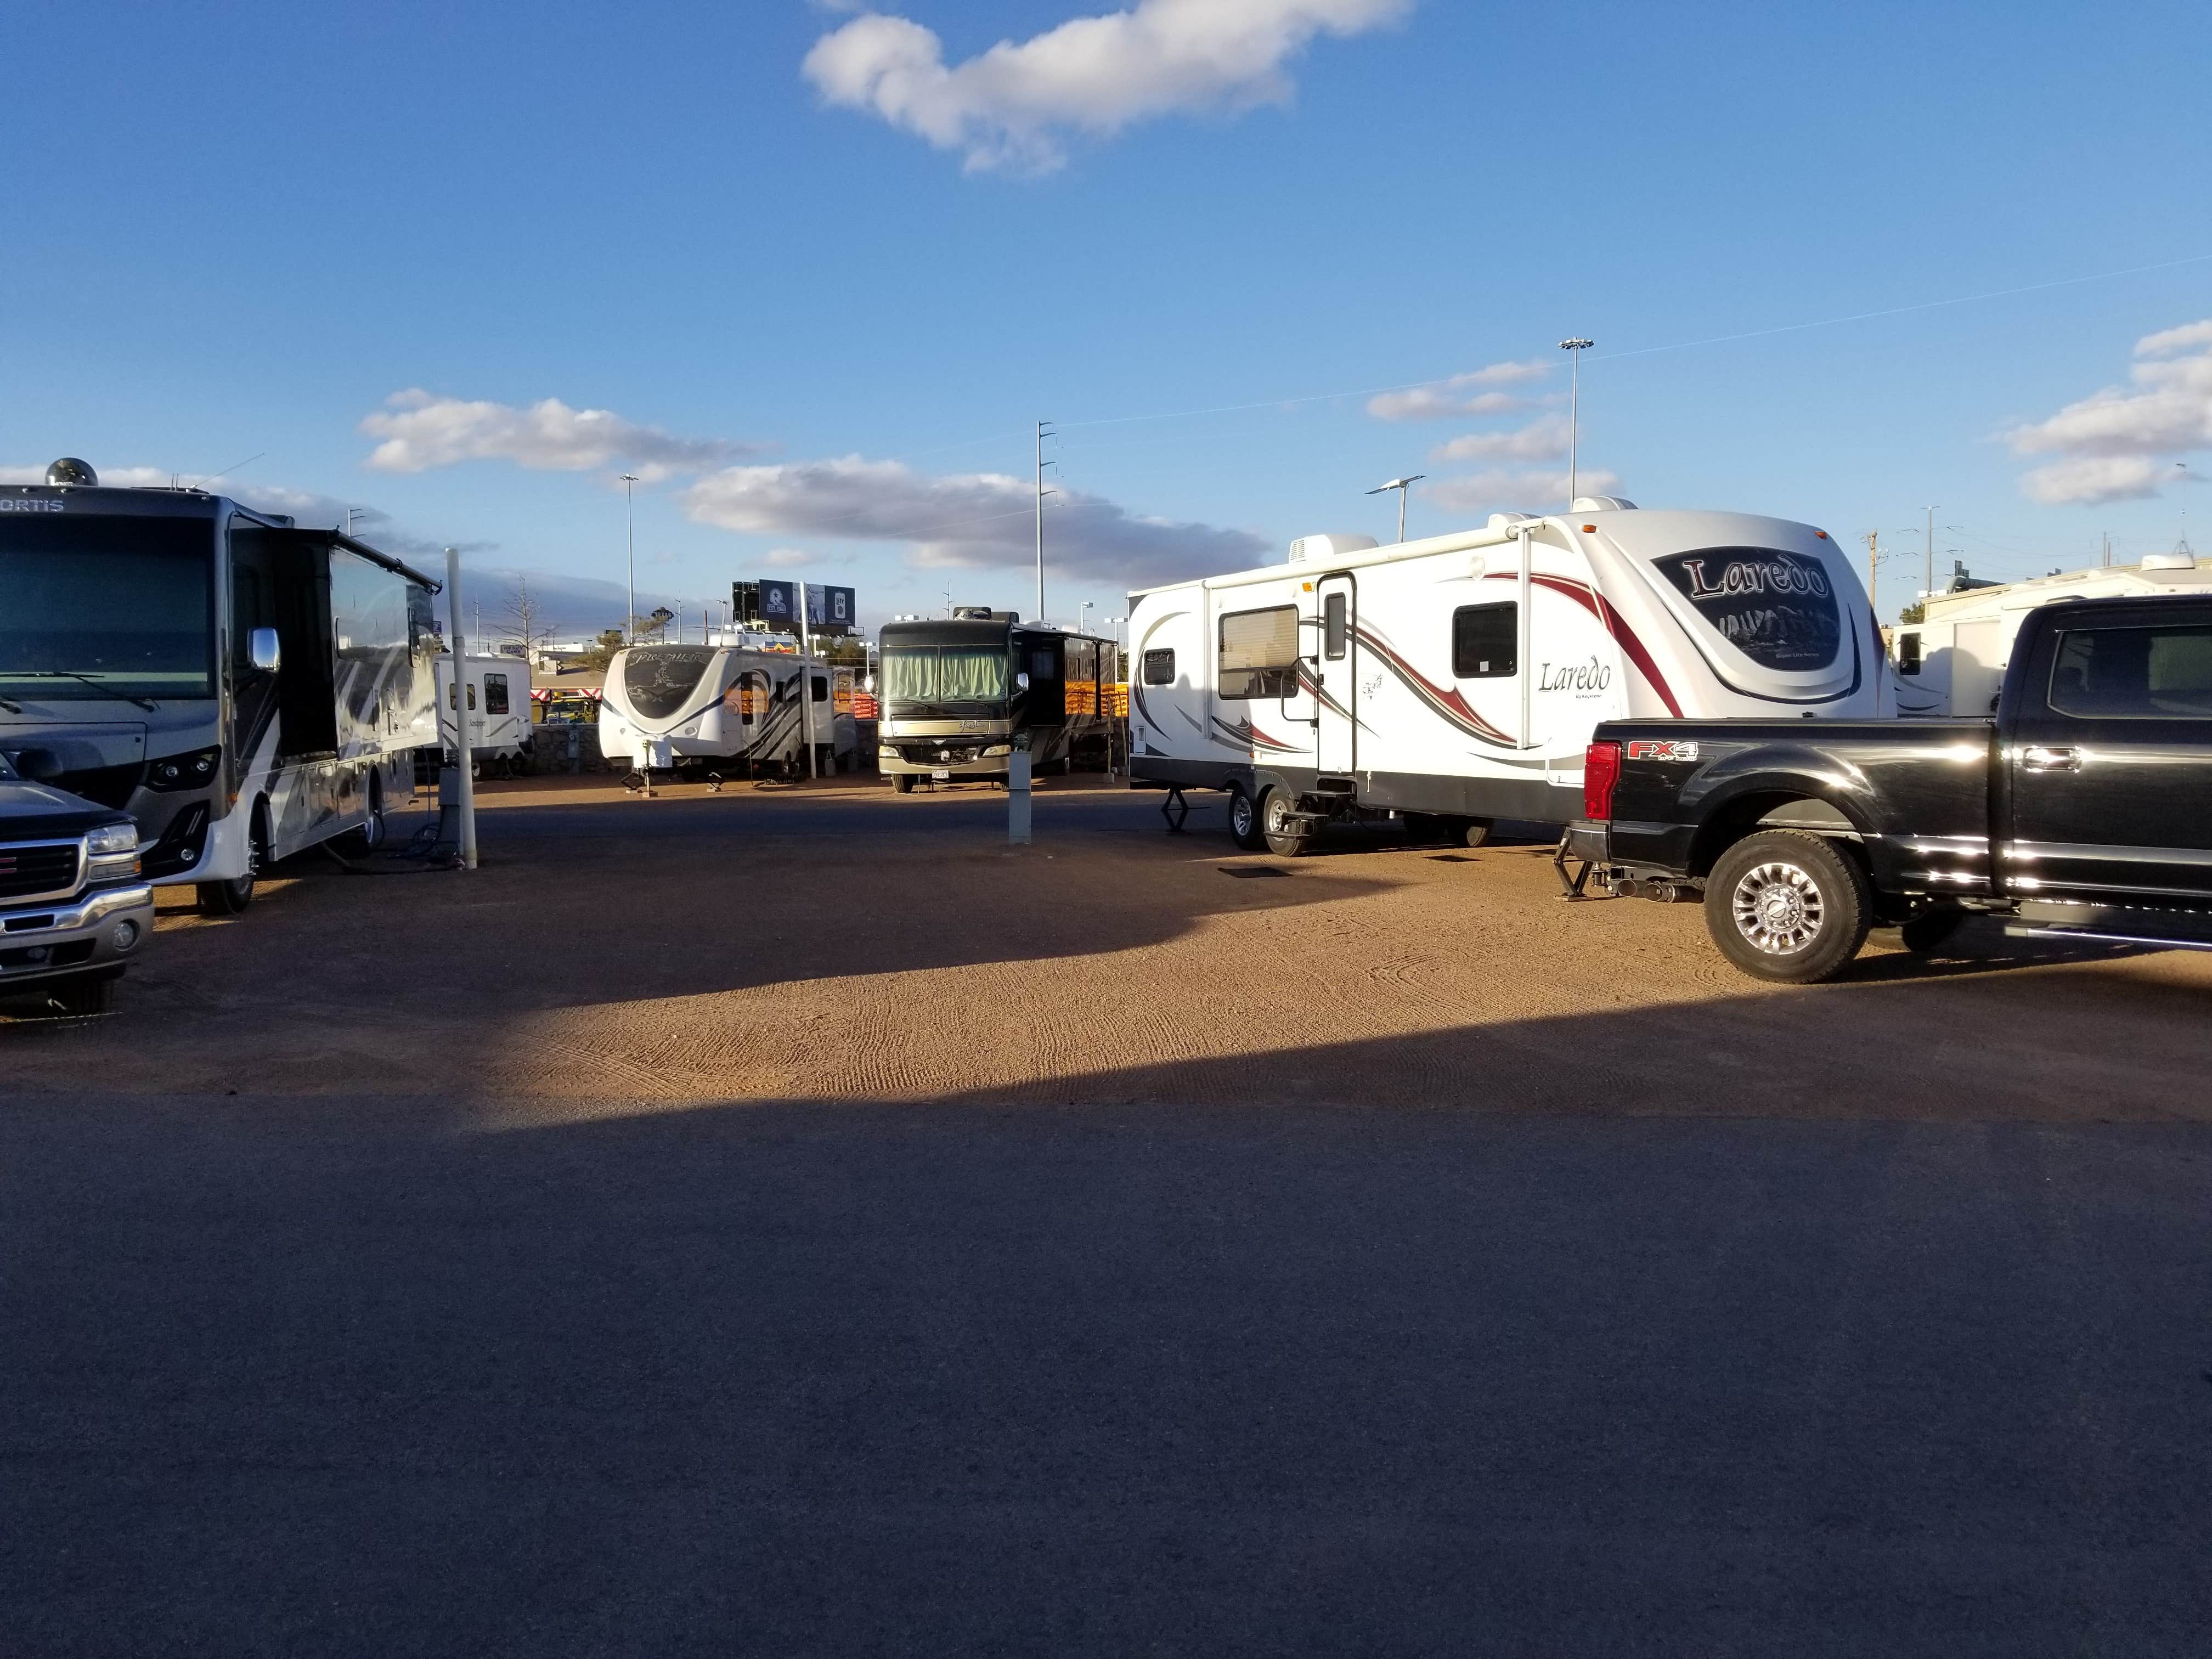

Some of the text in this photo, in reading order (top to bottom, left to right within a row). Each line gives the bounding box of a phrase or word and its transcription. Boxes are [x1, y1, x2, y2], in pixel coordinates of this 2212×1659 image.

[0, 499, 64, 512] ORTIS
[1683, 554, 1829, 599] Laredo
[1538, 655, 1611, 691] Laredo
[1628, 740, 1699, 760] FX4
